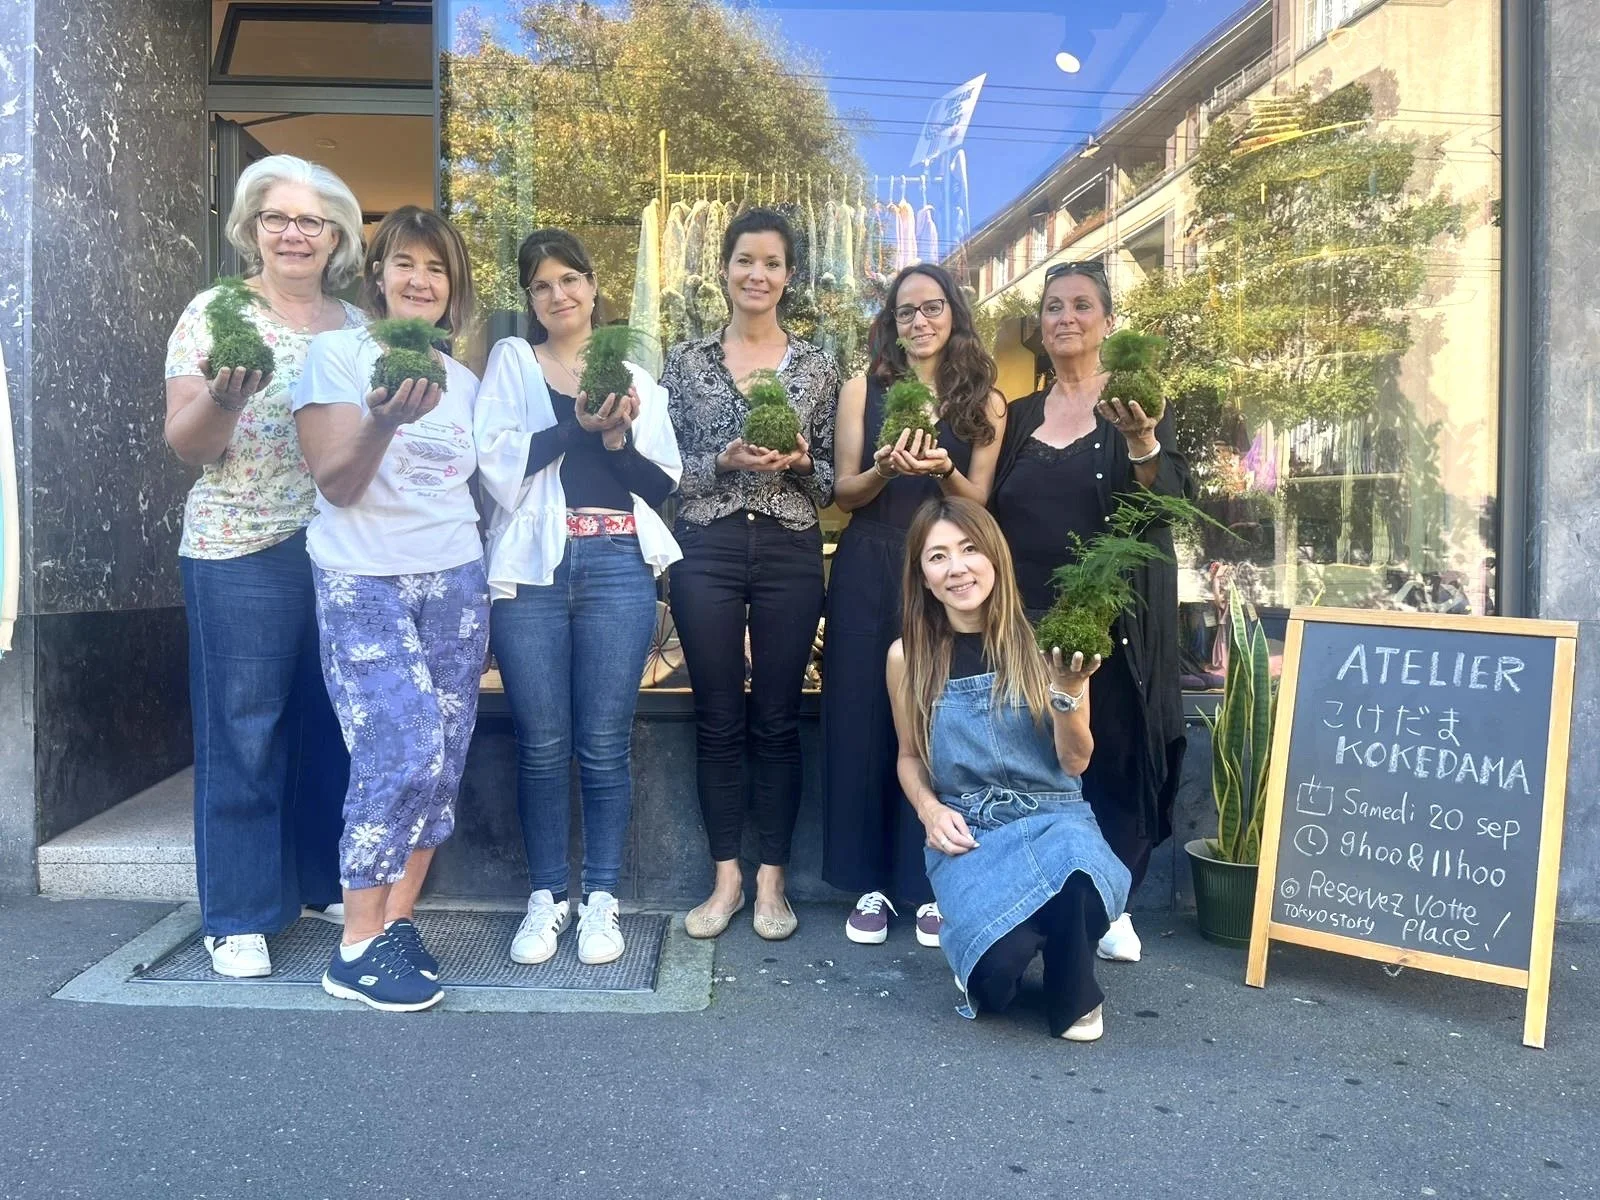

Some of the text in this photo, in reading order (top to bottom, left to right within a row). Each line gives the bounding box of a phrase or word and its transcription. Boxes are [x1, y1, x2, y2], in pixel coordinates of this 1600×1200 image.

[1336, 643, 1525, 692] ATELIER
[1322, 700, 1460, 746] こけだま
[1335, 735, 1531, 795] KOKEDAMA
[1342, 788, 1520, 850] Samedi 20 sep
[1307, 870, 1404, 917] Reservez
